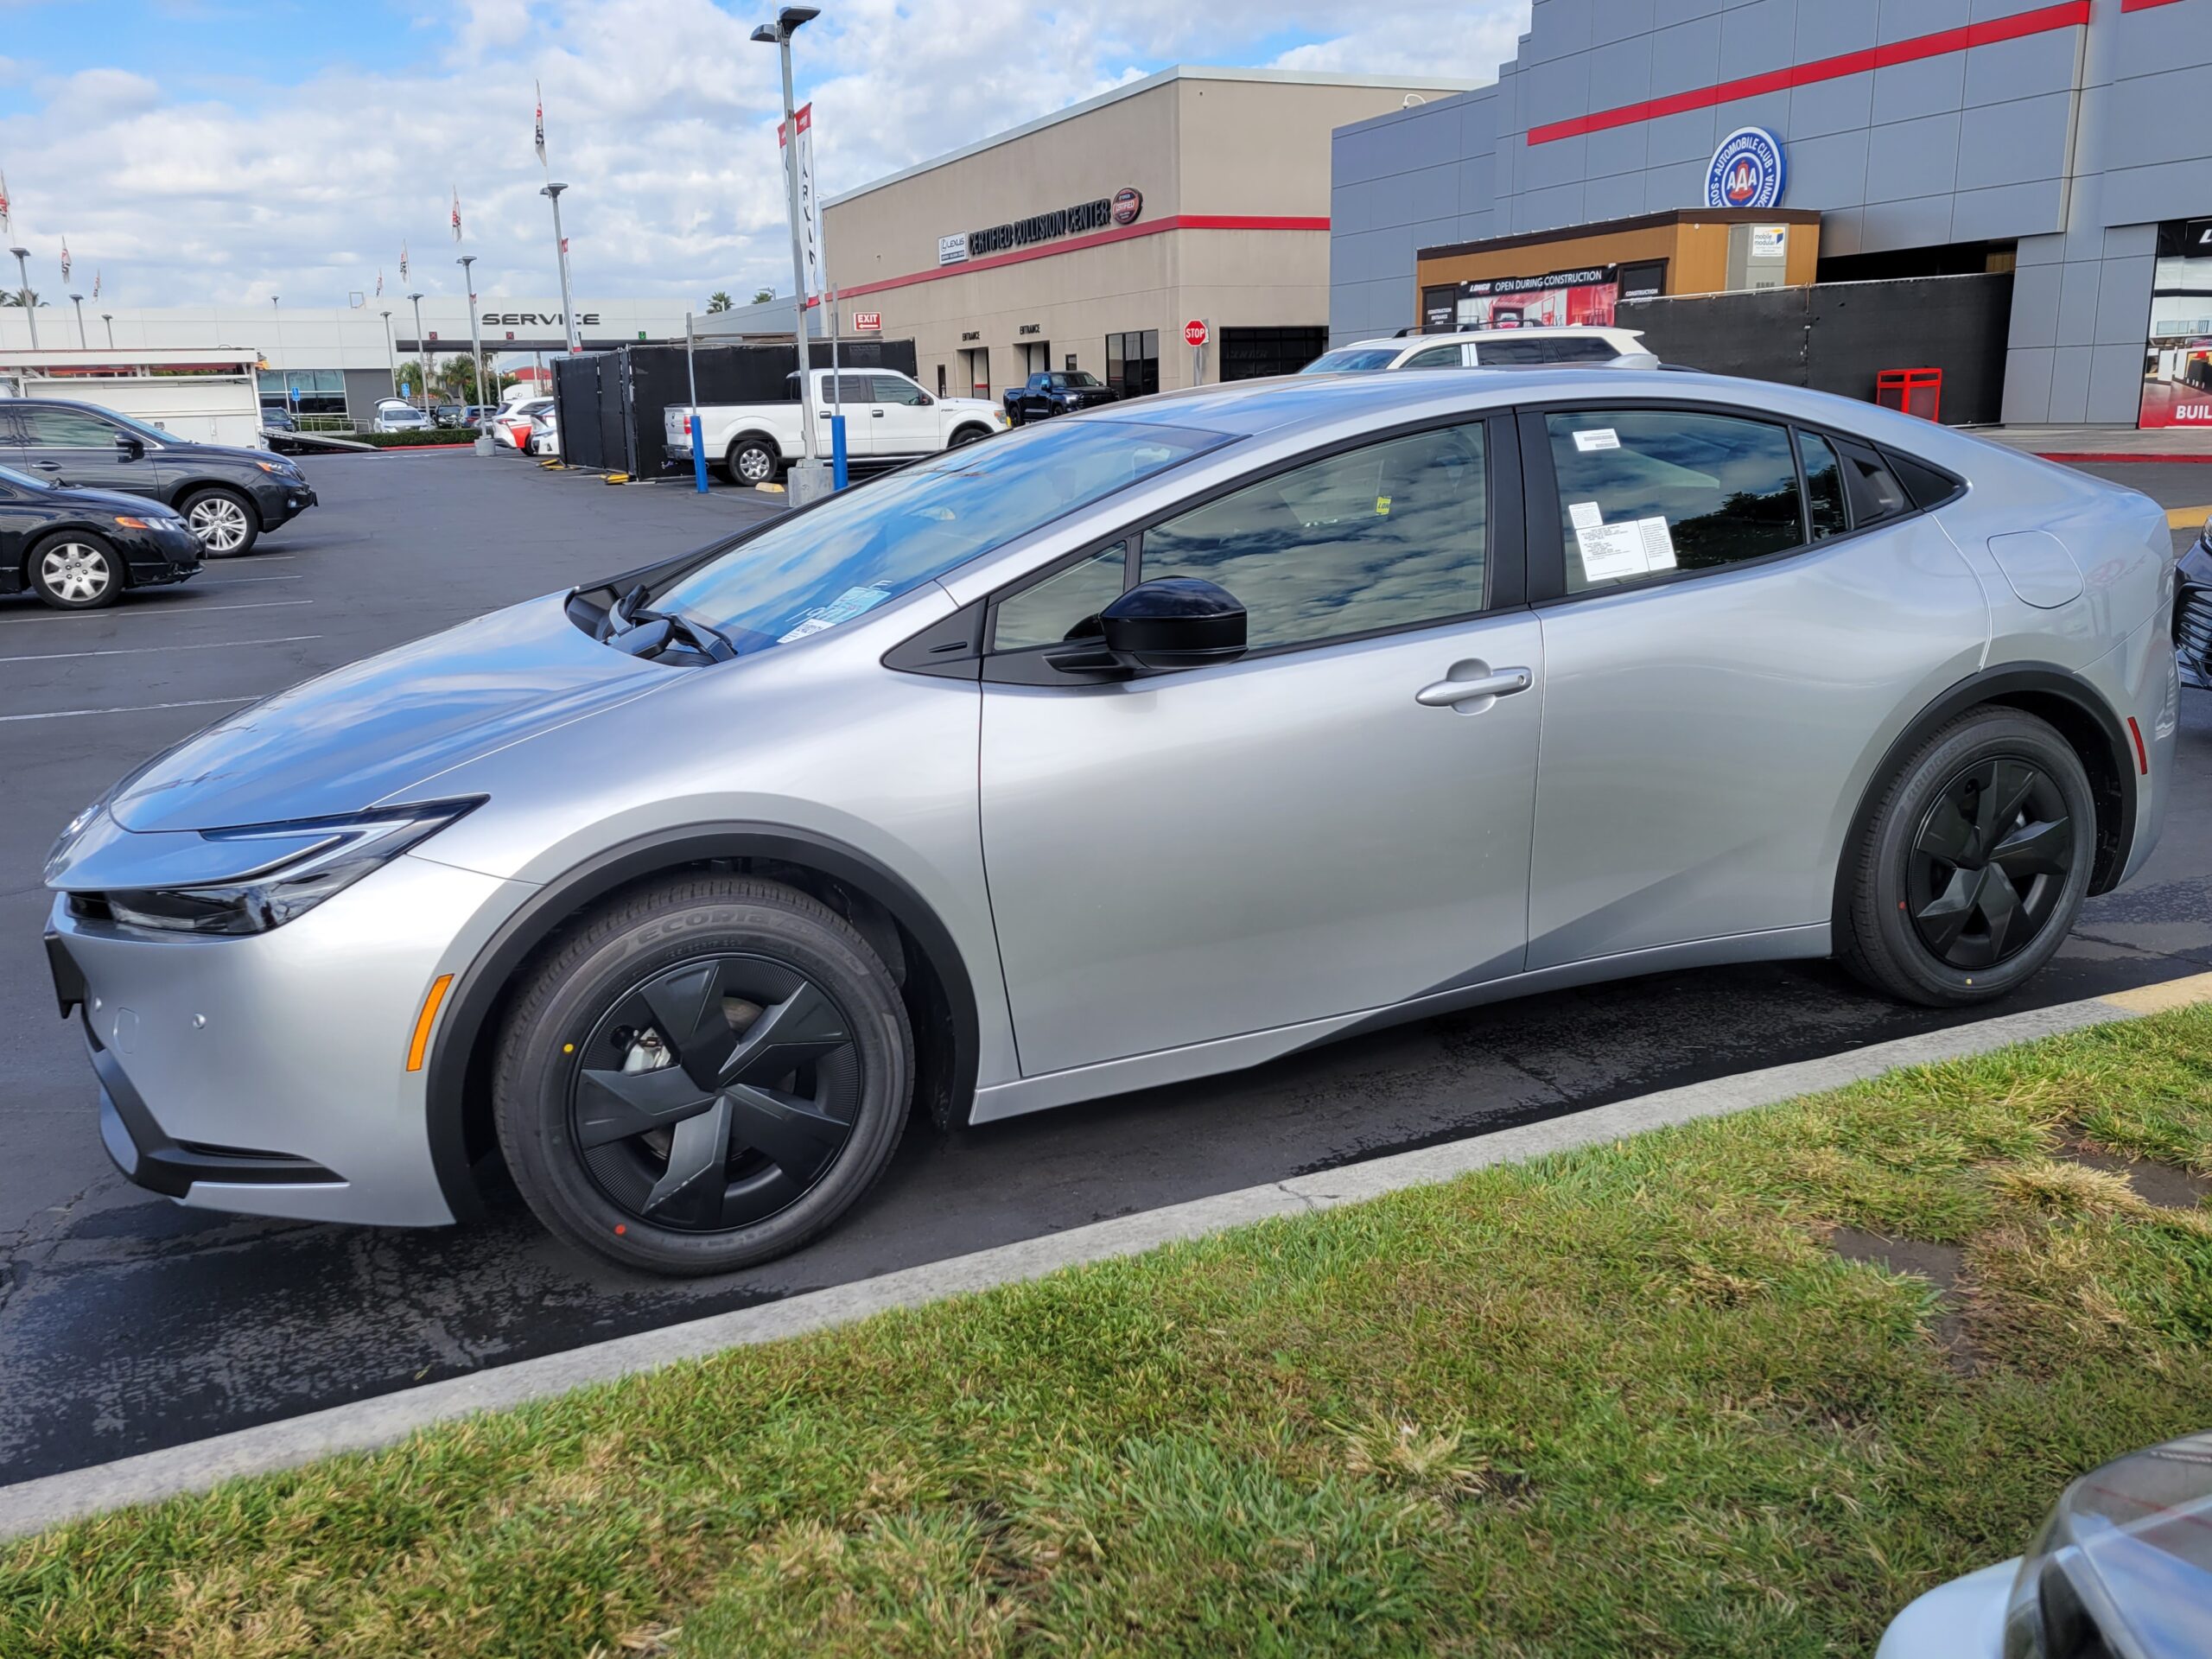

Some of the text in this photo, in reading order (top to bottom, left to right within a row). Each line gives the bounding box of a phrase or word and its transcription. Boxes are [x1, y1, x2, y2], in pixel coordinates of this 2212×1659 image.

[1714, 137, 1774, 175] AUTOMOBILE CLUB
[1726, 167, 1758, 193] AAA
[1754, 174, 1775, 207] ORNIA
[968, 199, 1112, 256] CERTIFIED COLLISION CENTER
[946, 237, 965, 248] LEXUS
[1495, 270, 1603, 292] OPEN DURING CONSTRUCTION
[1470, 283, 1491, 292] LONGO
[1625, 288, 1659, 297] CONSTRUCTION
[857, 314, 878, 323] EXIT
[1020, 324, 1040, 335] ENTRANCE
[1185, 327, 1205, 338] STOP
[962, 331, 981, 341] ENTRANCE
